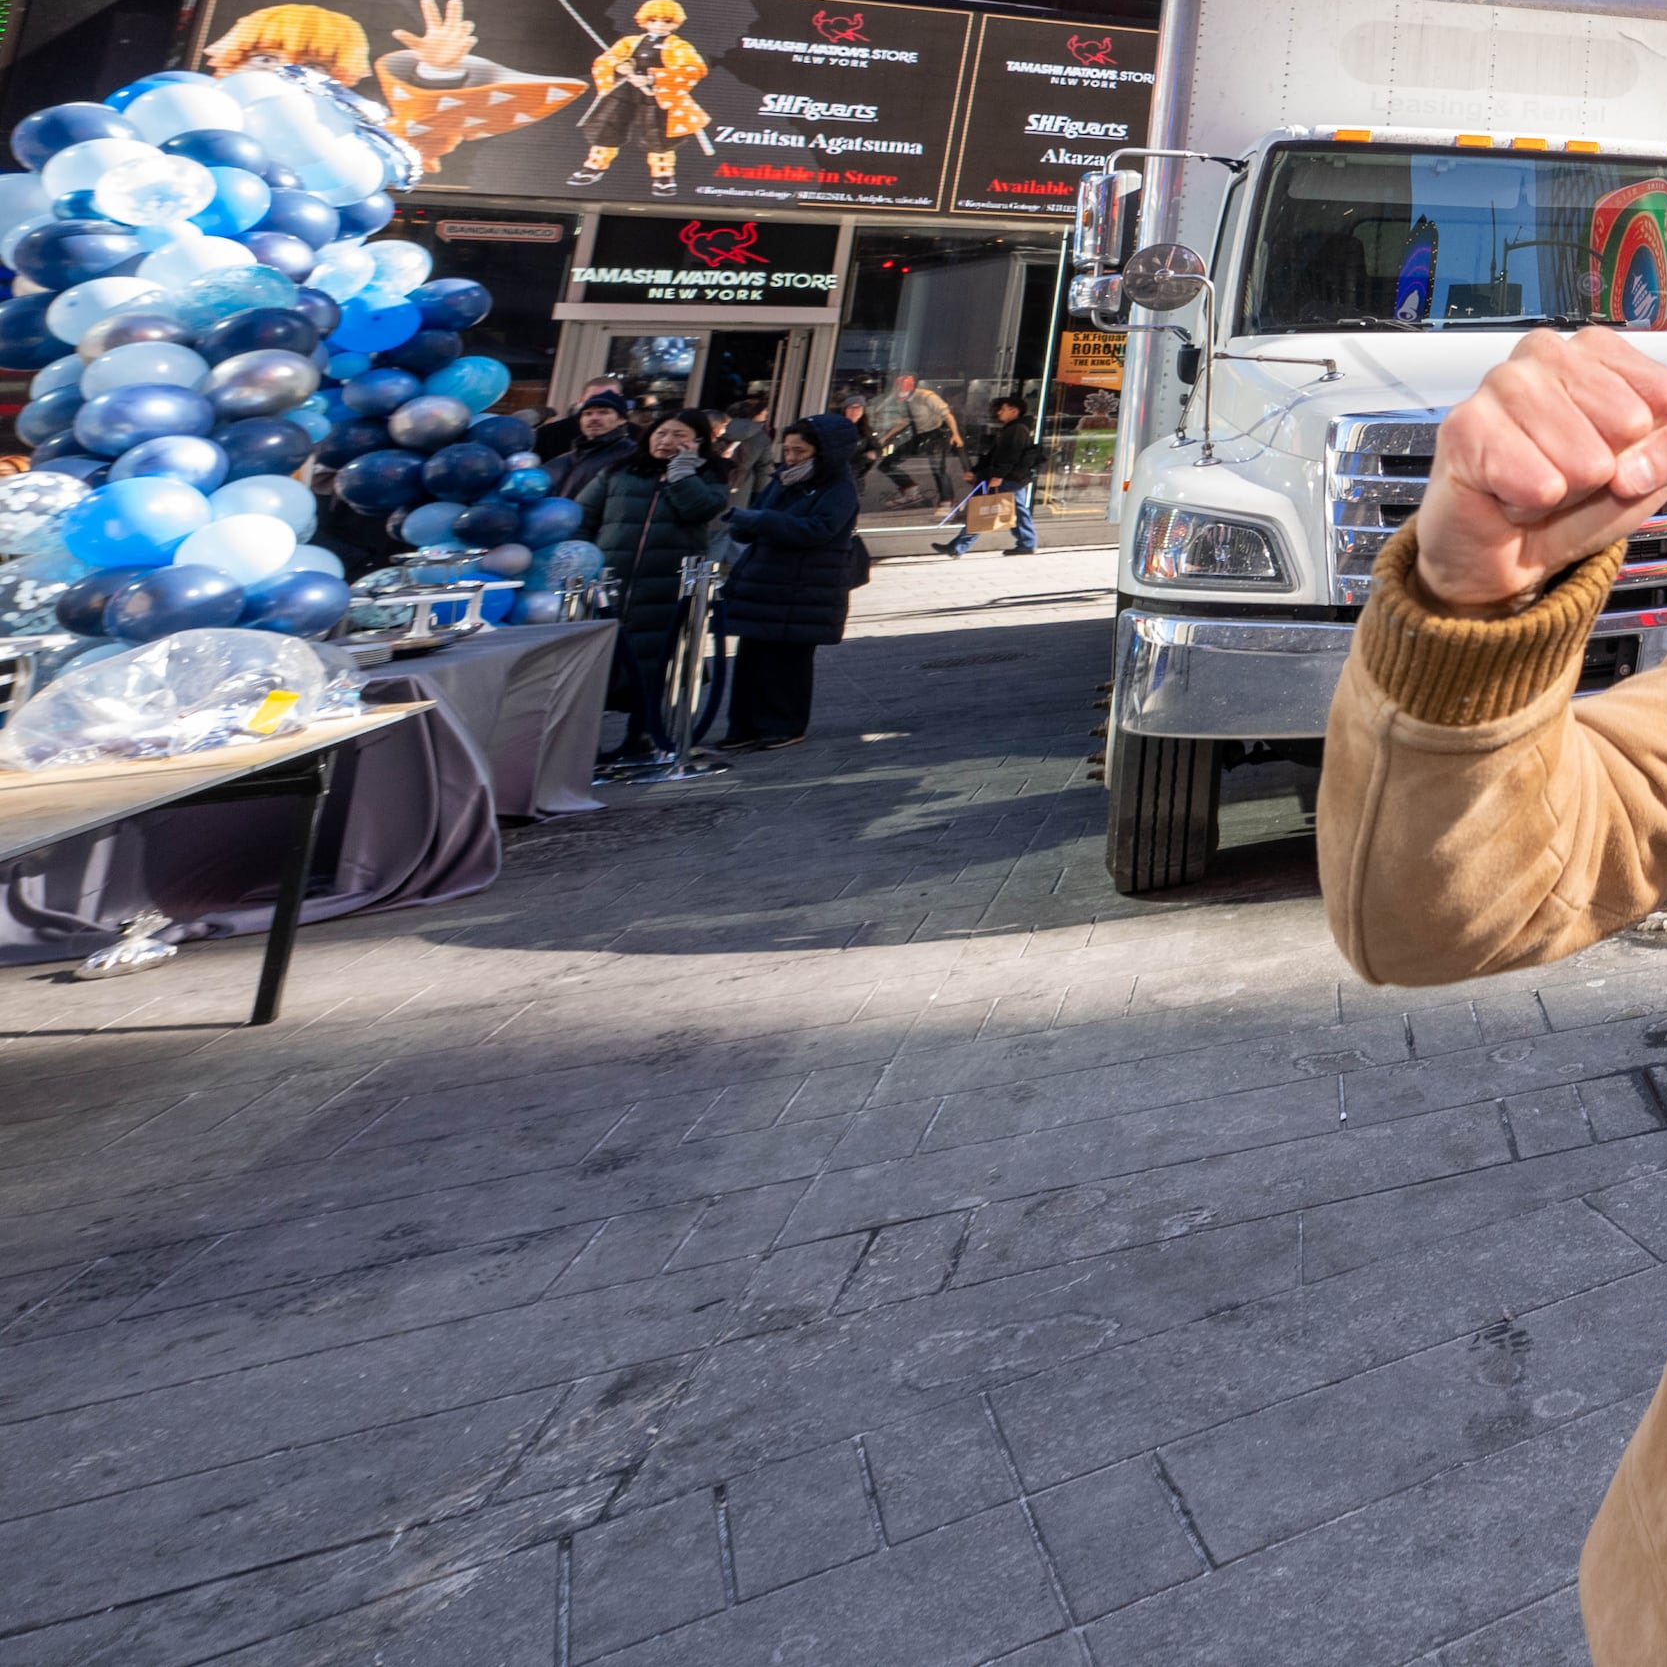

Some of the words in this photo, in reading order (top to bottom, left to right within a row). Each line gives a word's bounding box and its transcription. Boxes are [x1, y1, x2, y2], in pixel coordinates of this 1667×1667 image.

[741, 37, 808, 53] TAMASHII
[872, 49, 919, 63] STORE
[792, 55, 824, 64] NEW
[830, 57, 869, 69] YORK
[1006, 60, 1064, 76] TAMASHII
[1050, 77, 1079, 86] NEW
[1082, 79, 1117, 89] YORK
[1371, 91, 1486, 121] Leasing
[1521, 99, 1606, 125] Rental
[714, 126, 805, 148] Zenitsu
[808, 133, 923, 155] Agatsuma
[1040, 148, 1109, 166] Akaza
[714, 162, 815, 182] Available
[818, 166, 840, 183] in
[844, 170, 898, 186] Store
[987, 178, 1074, 196] Available
[571, 267, 673, 286] TAMASHII
[673, 270, 767, 287] NATIONS
[770, 272, 838, 290] STORE
[648, 288, 699, 300] NEW
[704, 288, 764, 301] YORK
[1071, 343, 1126, 355] RORON
